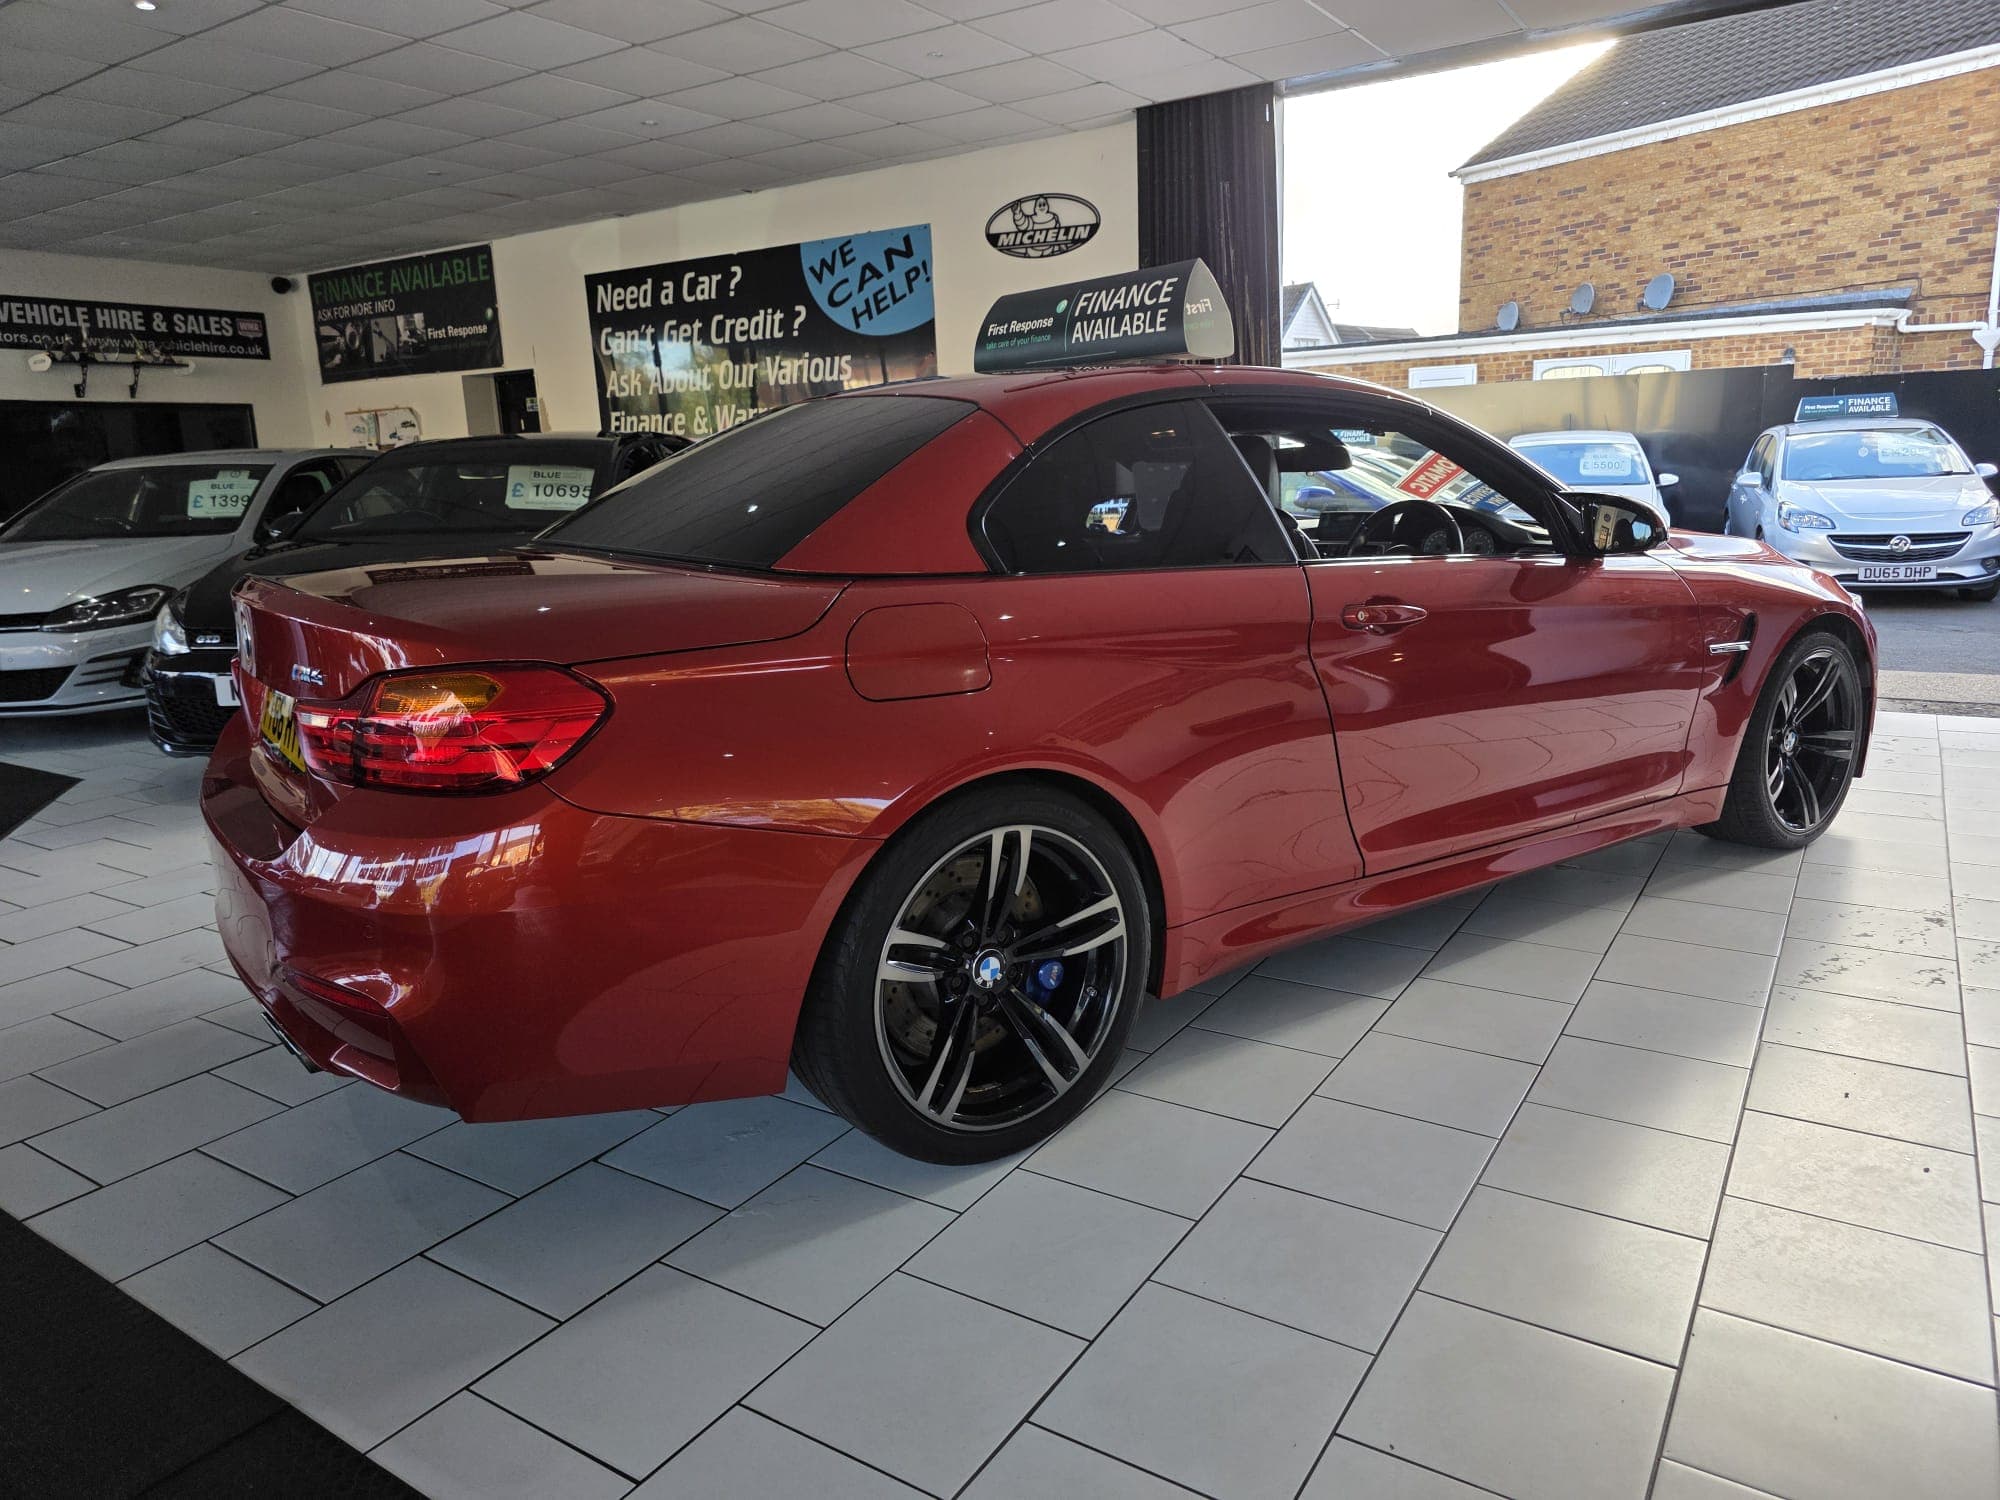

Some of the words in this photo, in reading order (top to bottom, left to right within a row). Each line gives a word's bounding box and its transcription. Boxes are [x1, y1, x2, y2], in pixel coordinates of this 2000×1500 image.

[997, 225, 1090, 246] MICHELIN
[809, 239, 856, 284] WE
[827, 233, 914, 308] CAN
[312, 271, 387, 303] FINANCE
[390, 254, 490, 293] AVAILABLE
[597, 278, 652, 313] Need
[660, 281, 674, 304] a
[682, 272, 721, 303] Car
[851, 260, 930, 329] HELP!
[1075, 277, 1179, 317] FINANCE
[0, 302, 91, 328] VEHICLE
[99, 308, 146, 331] HIRE
[152, 312, 169, 333] &
[173, 312, 233, 337] SALES
[317, 308, 333, 321] ASK
[333, 305, 350, 319] FOR
[350, 301, 373, 316] MORE
[374, 298, 396, 313] INFO
[427, 327, 447, 340] First
[447, 325, 488, 338] Response
[663, 318, 703, 346] Get
[710, 308, 784, 344] Credit
[988, 323, 1008, 337] First
[1009, 317, 1054, 334] Response
[1071, 308, 1169, 344] AVAILABLE
[1017, 336, 1030, 347] your
[606, 369, 642, 398] Ask
[650, 363, 712, 394] About
[718, 359, 757, 390] Our
[765, 351, 852, 386] Various
[1848, 396, 1891, 406] FINANCE
[1848, 404, 1891, 414] AVAILABLE
[609, 410, 686, 436] Finance
[693, 406, 708, 435] &
[533, 471, 562, 479] BLUE
[193, 494, 204, 508] £
[511, 482, 525, 498] £
[533, 483, 593, 499] 10695
[1863, 567, 1900, 579] DU65
[1903, 566, 1932, 578] DHP
